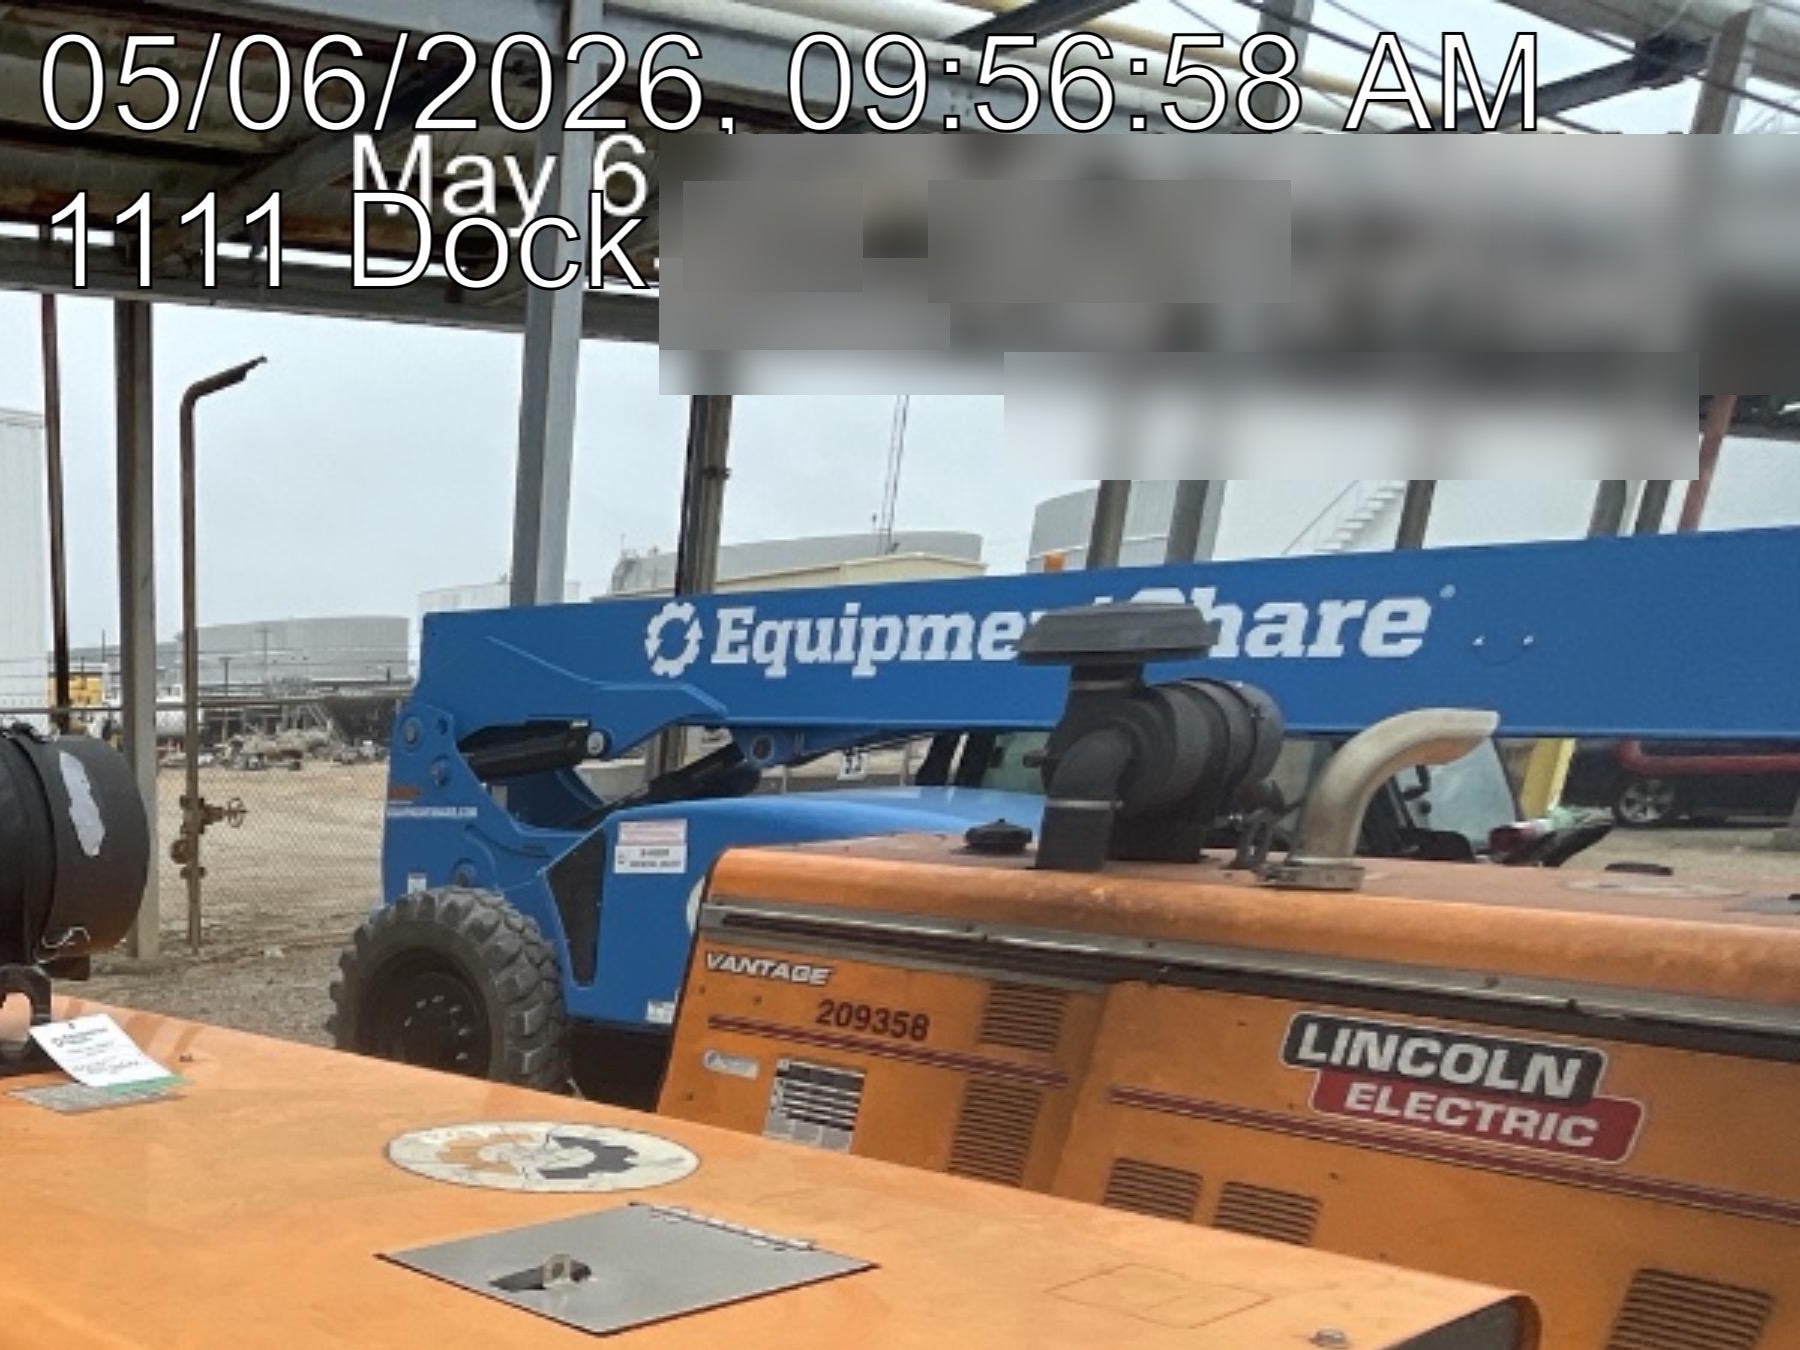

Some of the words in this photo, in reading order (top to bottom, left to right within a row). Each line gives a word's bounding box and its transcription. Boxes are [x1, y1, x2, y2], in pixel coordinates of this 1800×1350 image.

[711, 586, 1432, 679] Equipmehare
[705, 952, 834, 985] VANTAGE
[815, 999, 930, 1041] 209358
[1296, 1021, 1583, 1099] LINCOLN
[1344, 1082, 1599, 1148] ELECTRIC
